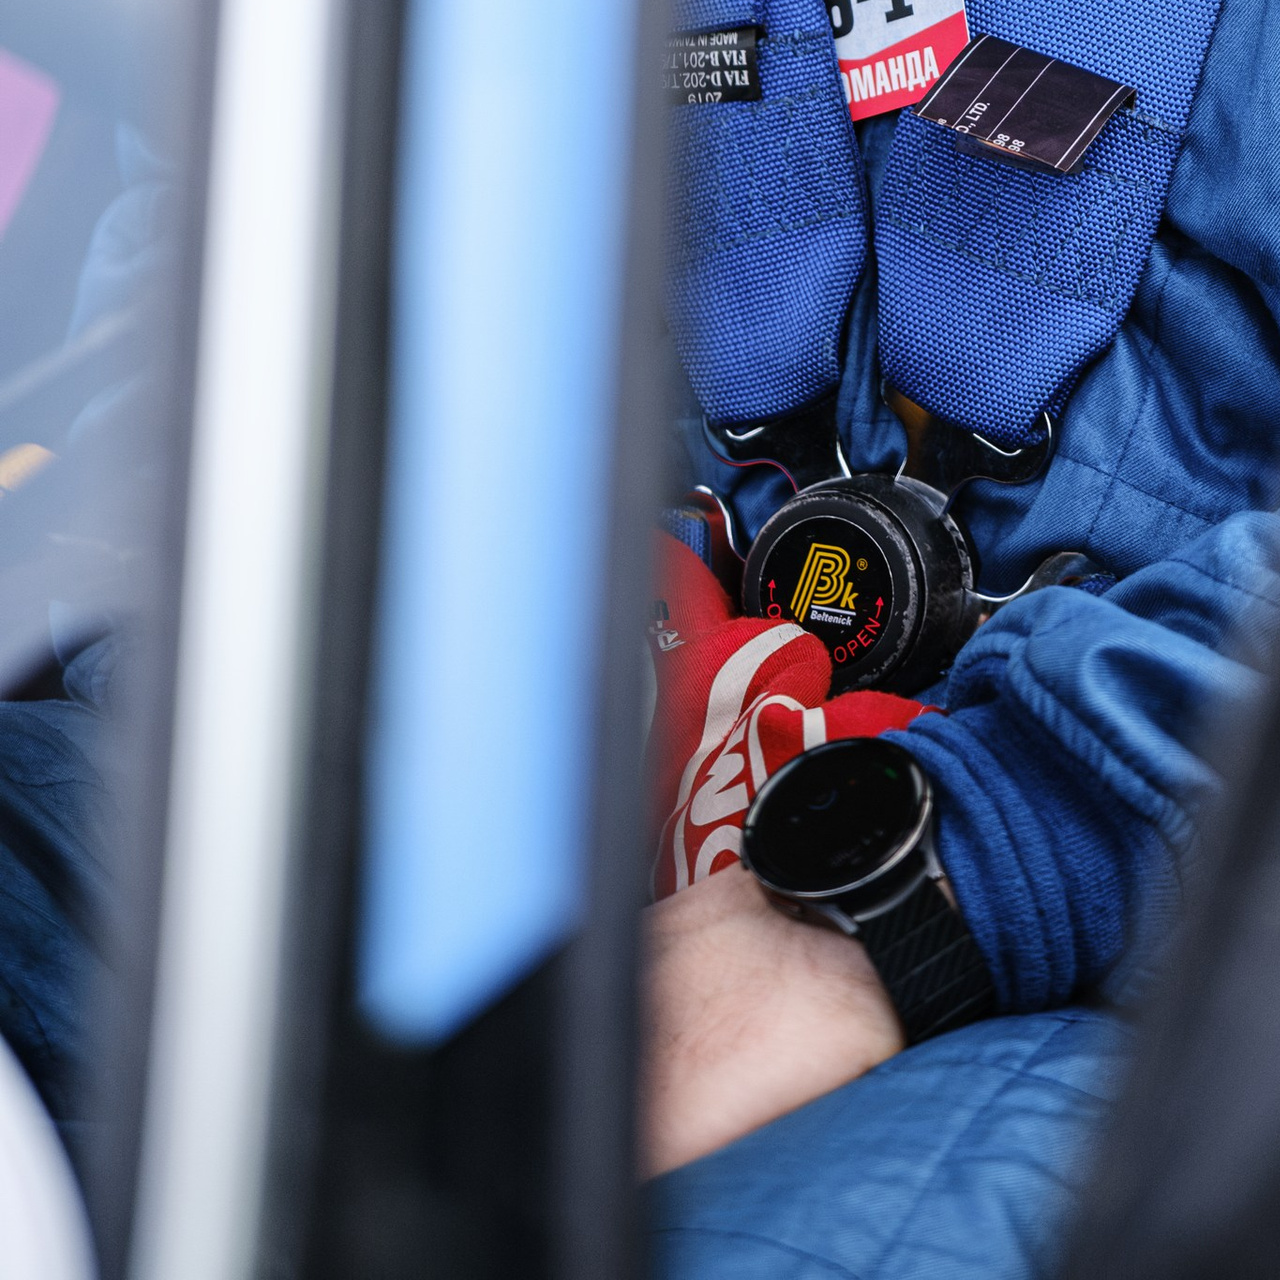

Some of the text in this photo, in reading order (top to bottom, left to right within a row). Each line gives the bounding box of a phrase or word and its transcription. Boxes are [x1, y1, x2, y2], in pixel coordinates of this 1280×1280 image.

[698, 34, 708, 47] IN
[710, 32, 738, 47] MADE
[722, 50, 747, 66] FIA
[724, 70, 749, 87] FIA
[965, 102, 991, 121] LTD.
[810, 610, 853, 626] Beltenick
[834, 617, 881, 663] OPEN
